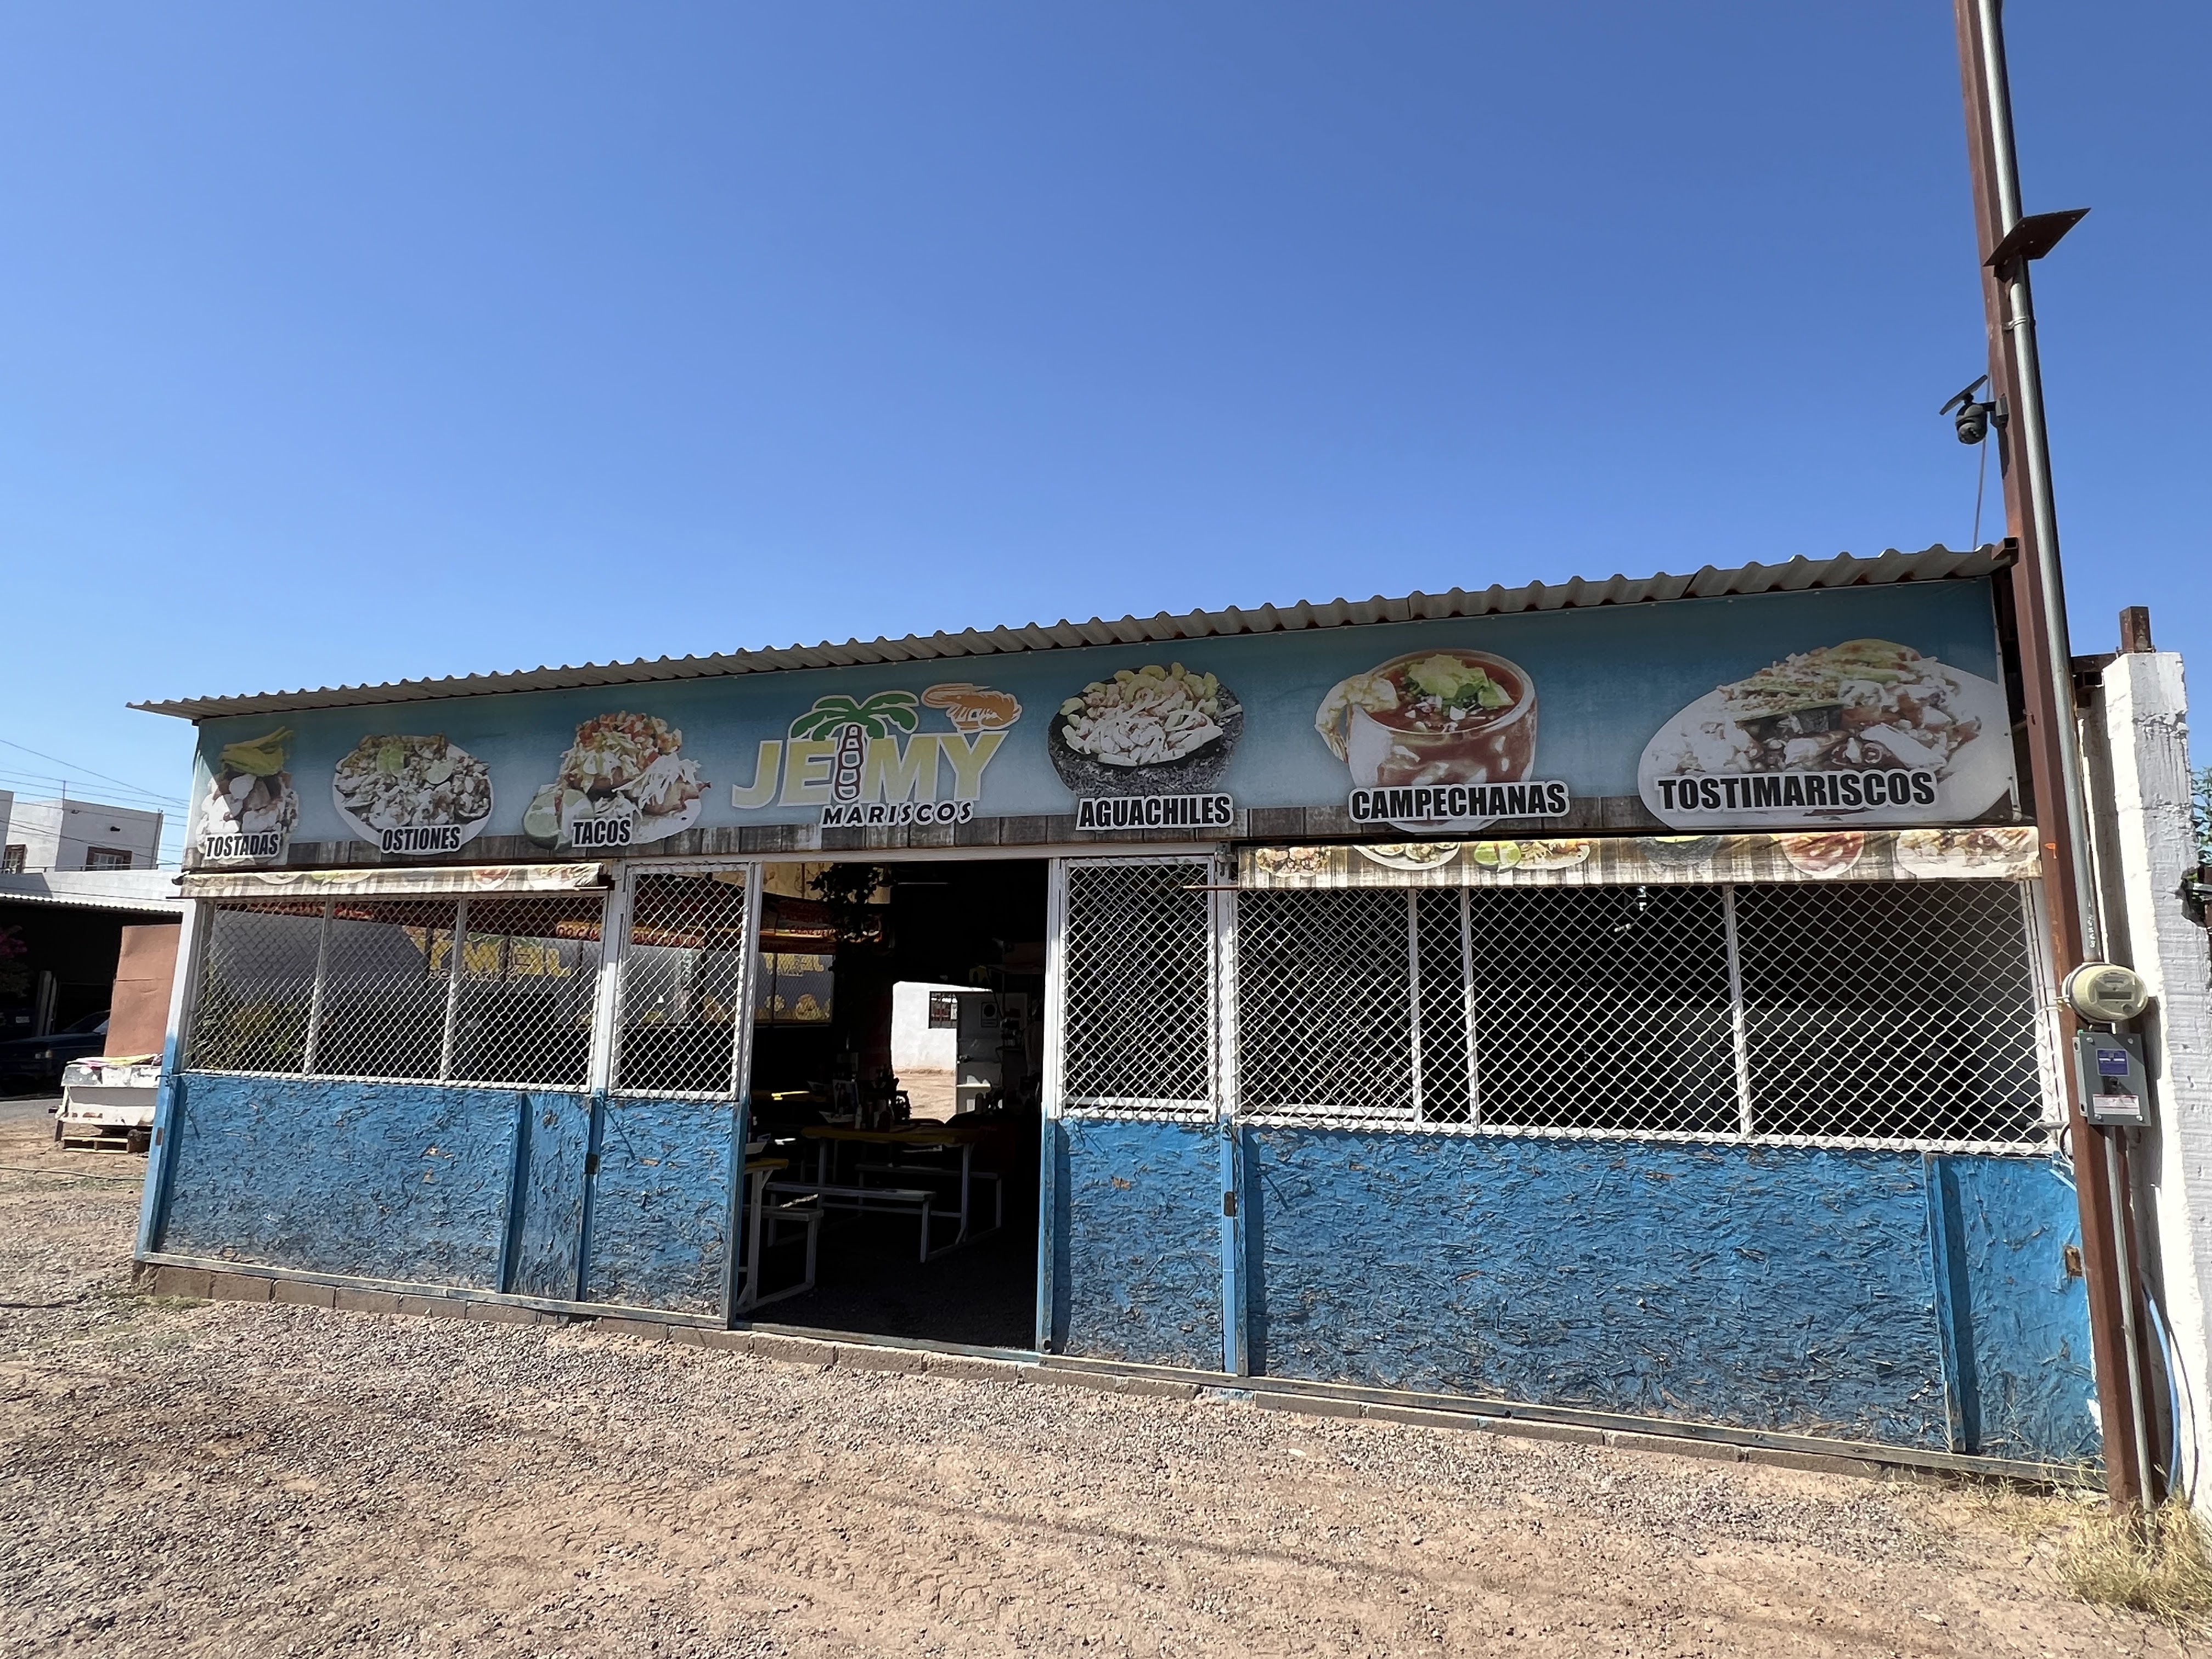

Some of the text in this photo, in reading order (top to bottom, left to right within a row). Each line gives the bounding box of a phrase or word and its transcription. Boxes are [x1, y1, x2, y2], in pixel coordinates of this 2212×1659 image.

[732, 730, 1009, 808] JEMY
[1352, 785, 1571, 821] CAMPECHANAS
[1658, 771, 1935, 810] TOSTIMARISCOS
[821, 802, 974, 827] MARISCOS
[1078, 799, 1231, 828] AGUACHILES
[206, 833, 279, 857] TOSTADAS
[382, 826, 460, 851] OSTIONES
[573, 819, 630, 845] TACOS
